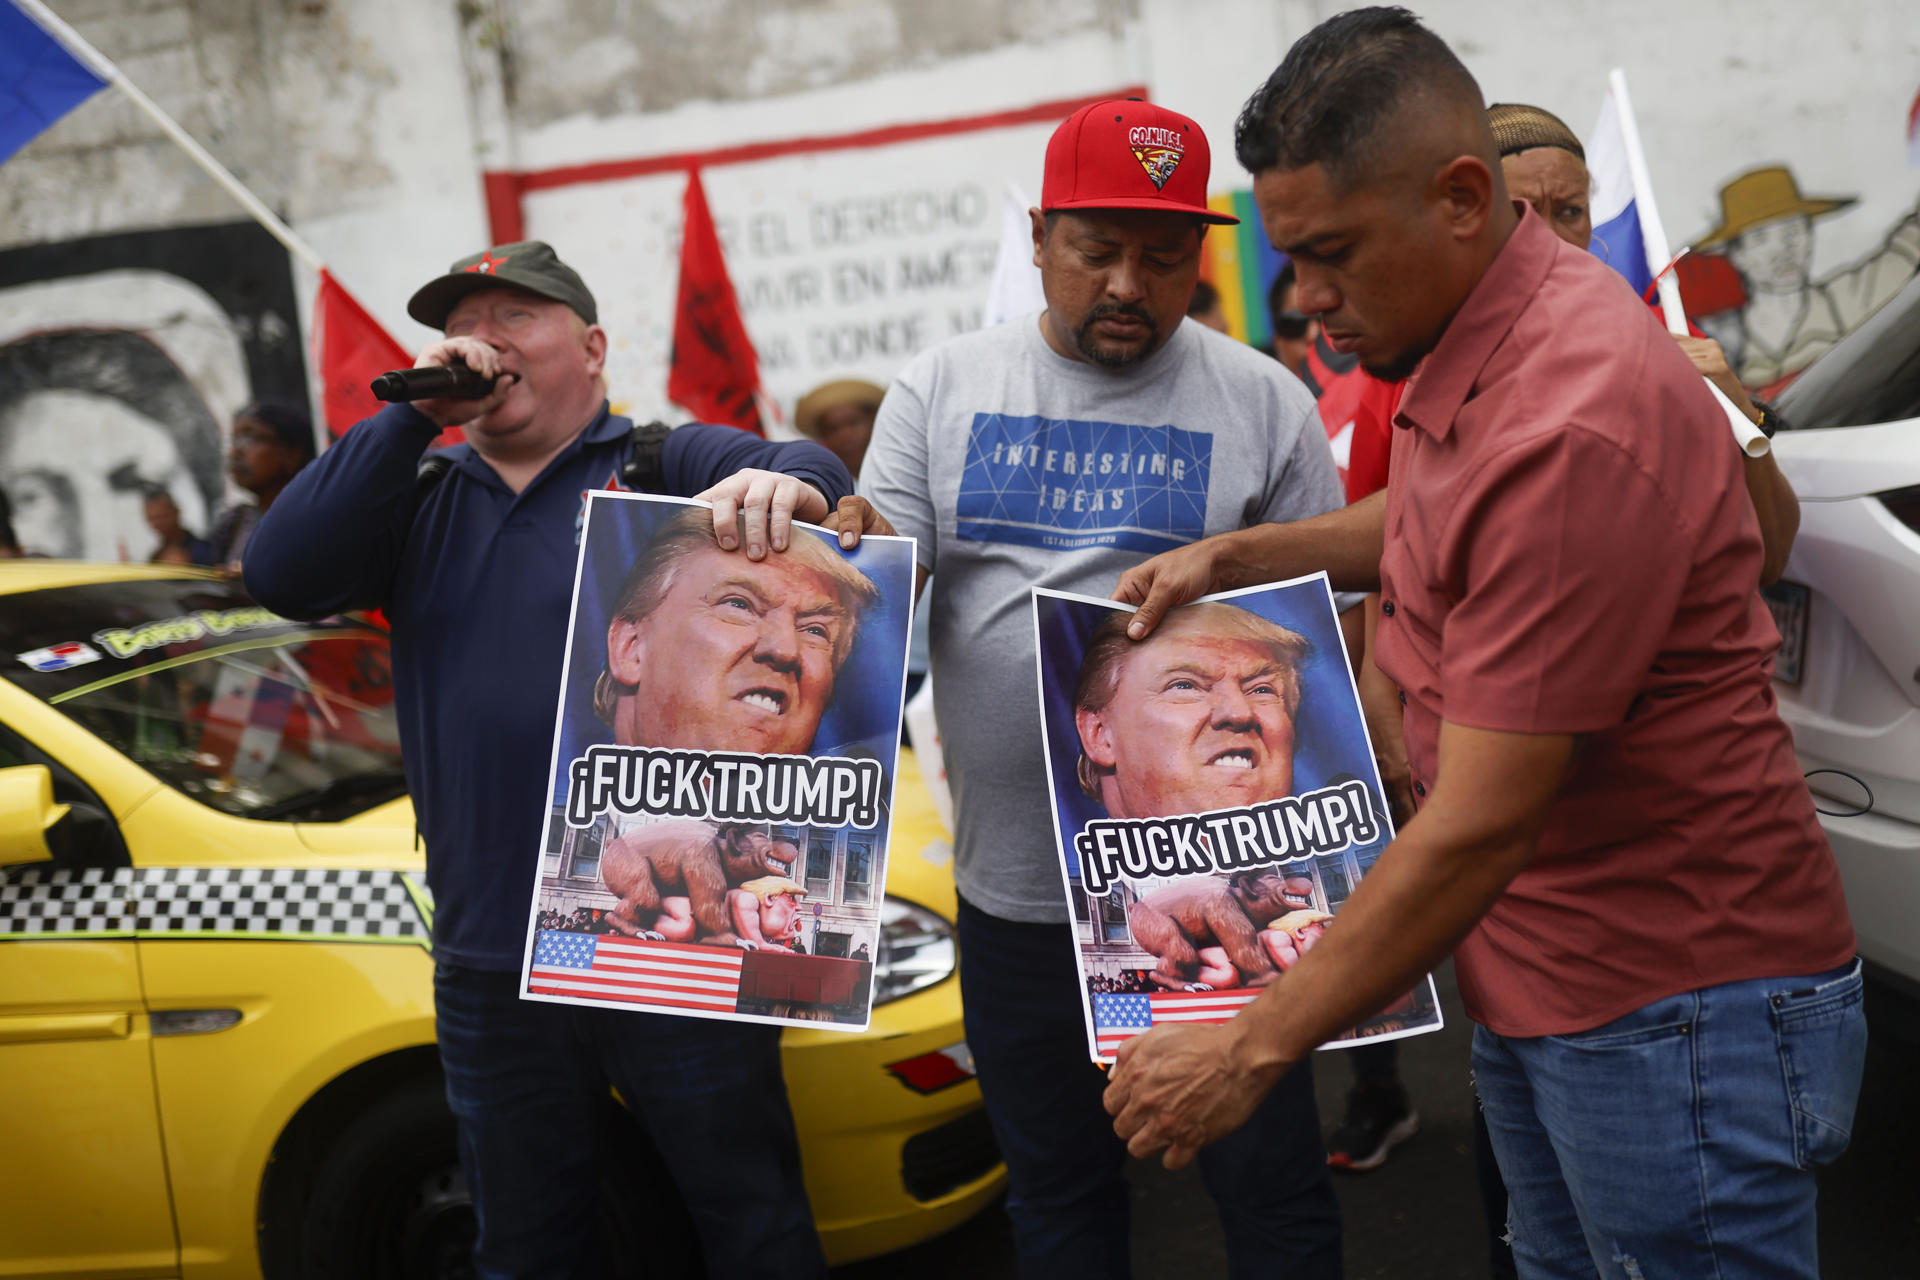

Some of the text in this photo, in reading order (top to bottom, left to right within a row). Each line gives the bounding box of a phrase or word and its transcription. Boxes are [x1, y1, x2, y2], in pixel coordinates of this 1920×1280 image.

[750, 208, 794, 259] EL
[832, 255, 887, 302] EN
[993, 442, 1187, 480] INTERESTING
[1039, 484, 1126, 513] IDEAS
[573, 753, 874, 821] ¡FUCK TRUMP!
[1082, 788, 1371, 889] ¡FUCK TRUMP!
